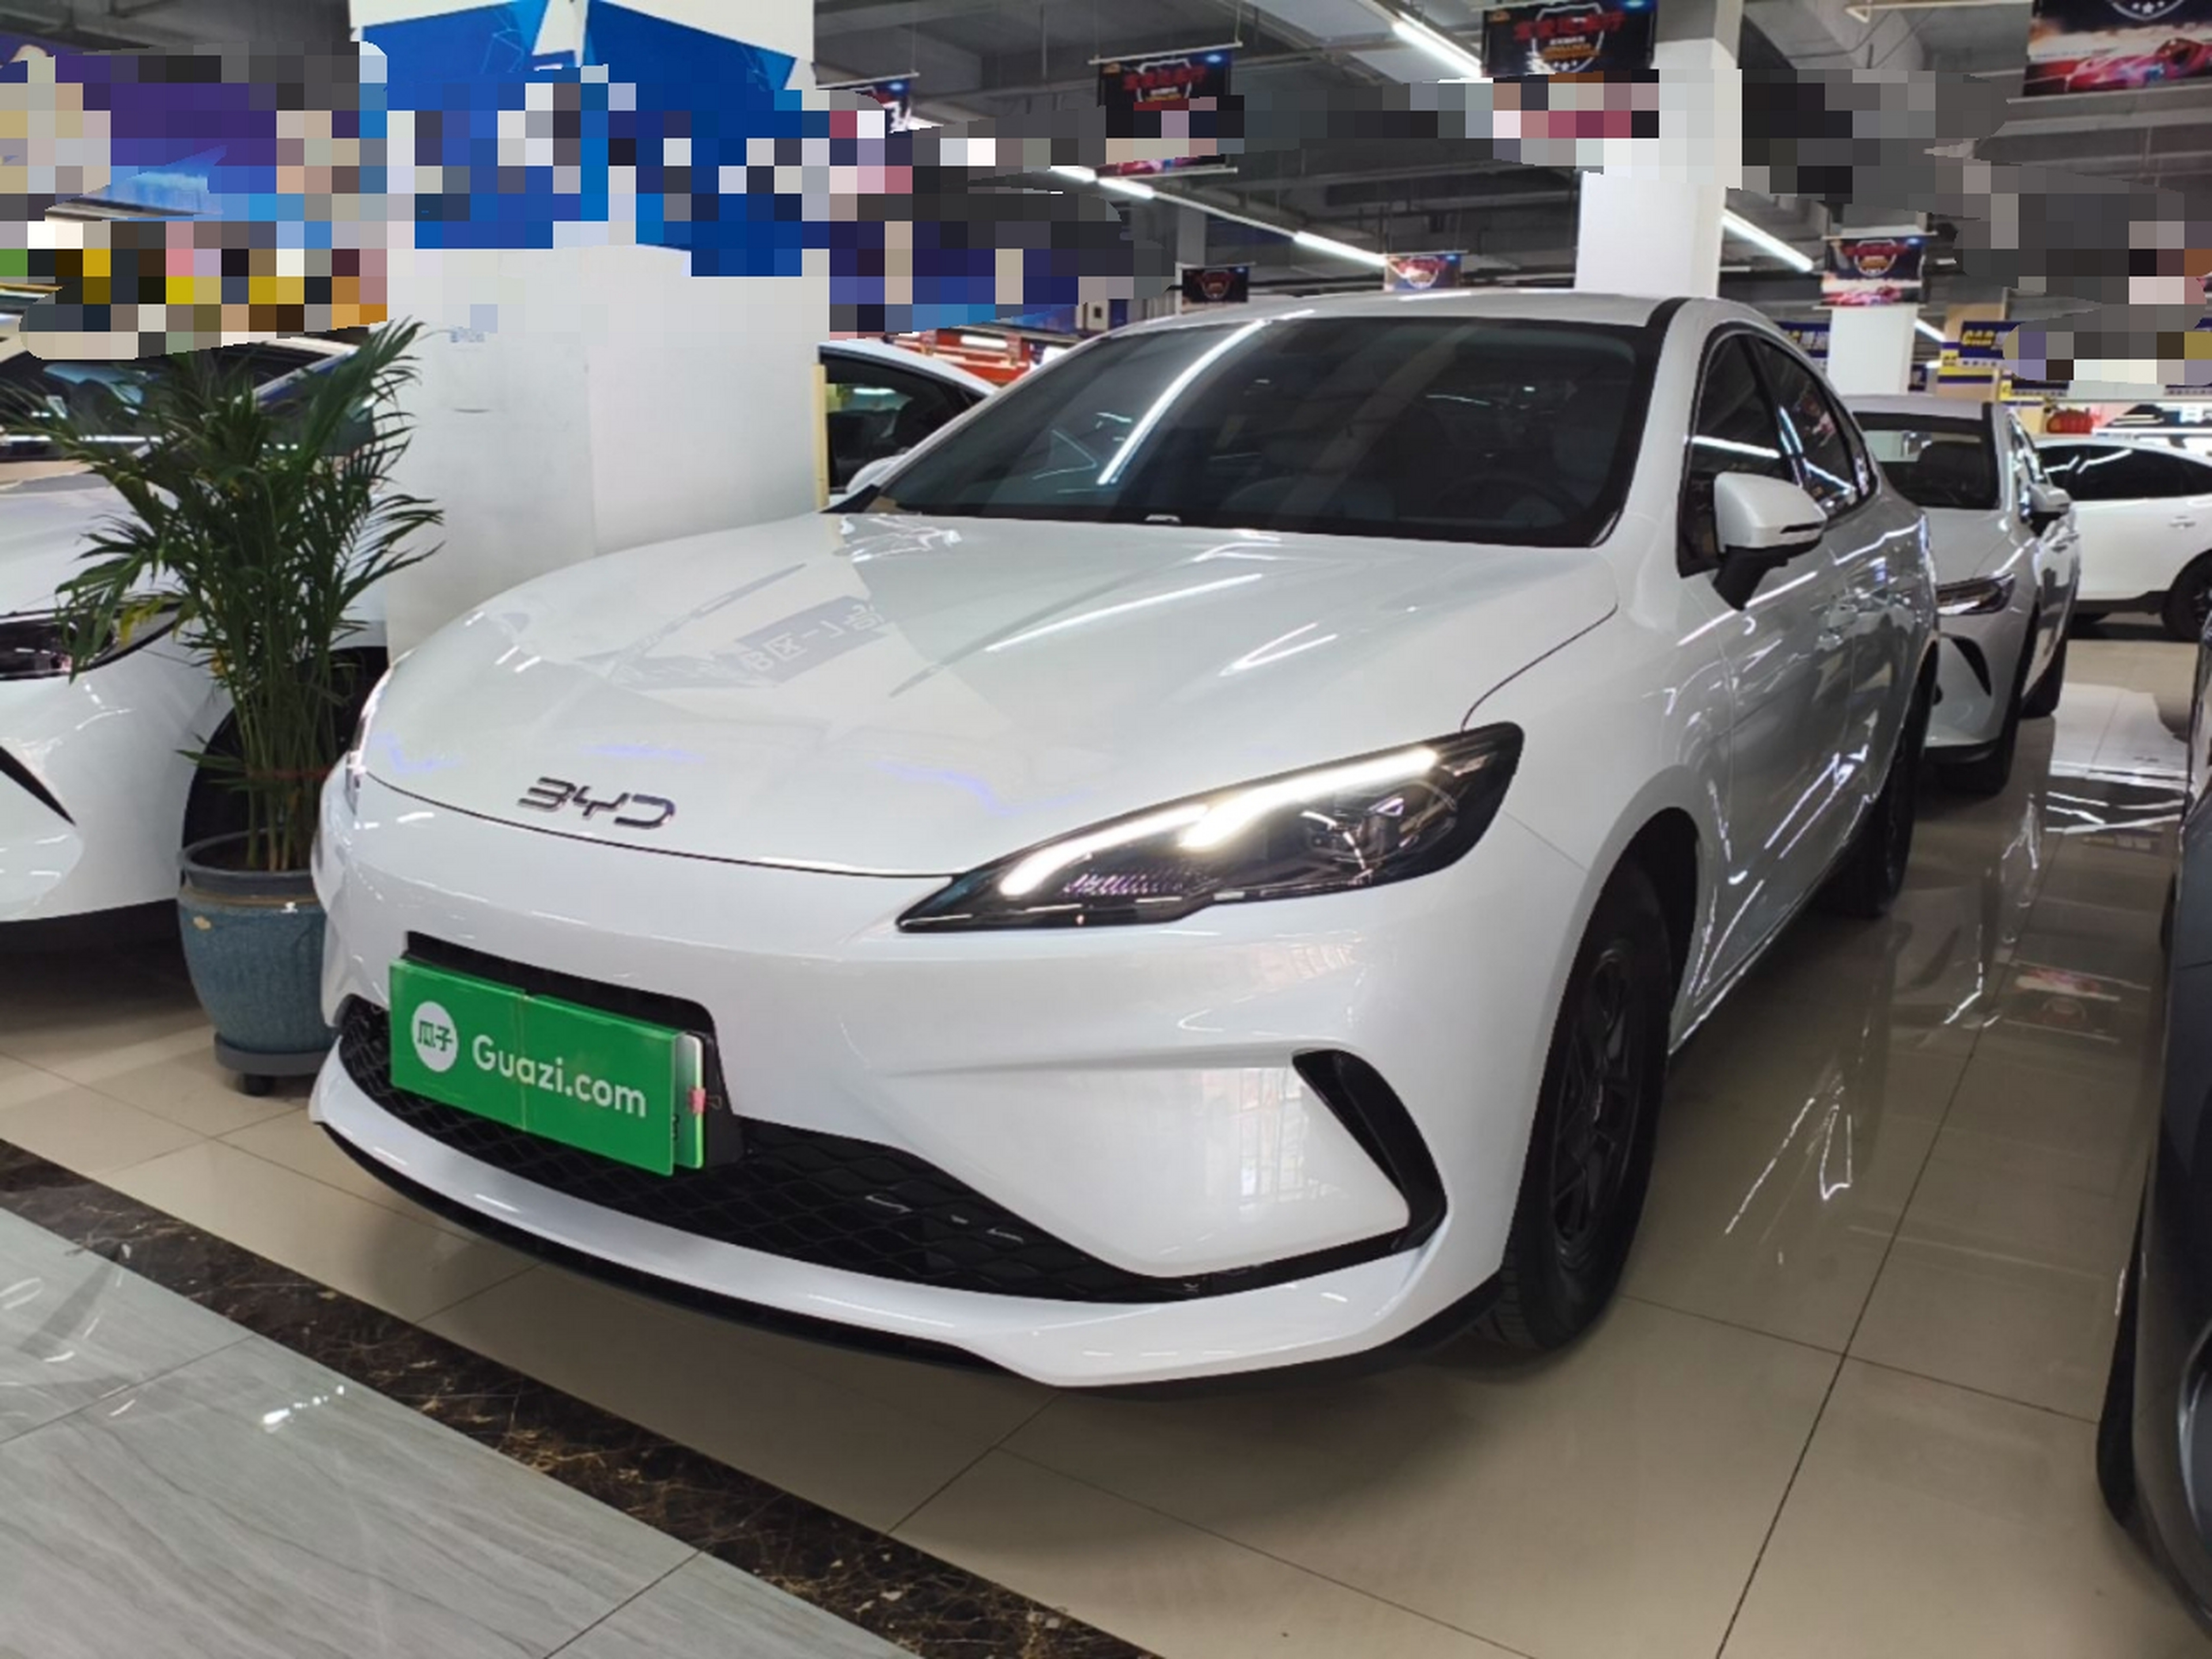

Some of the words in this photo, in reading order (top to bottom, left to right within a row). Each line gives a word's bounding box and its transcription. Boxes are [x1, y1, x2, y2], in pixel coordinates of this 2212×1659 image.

[518, 777, 675, 829] BYD
[418, 1020, 453, 1051] 瓜子
[472, 1035, 646, 1118] Guazi.com
